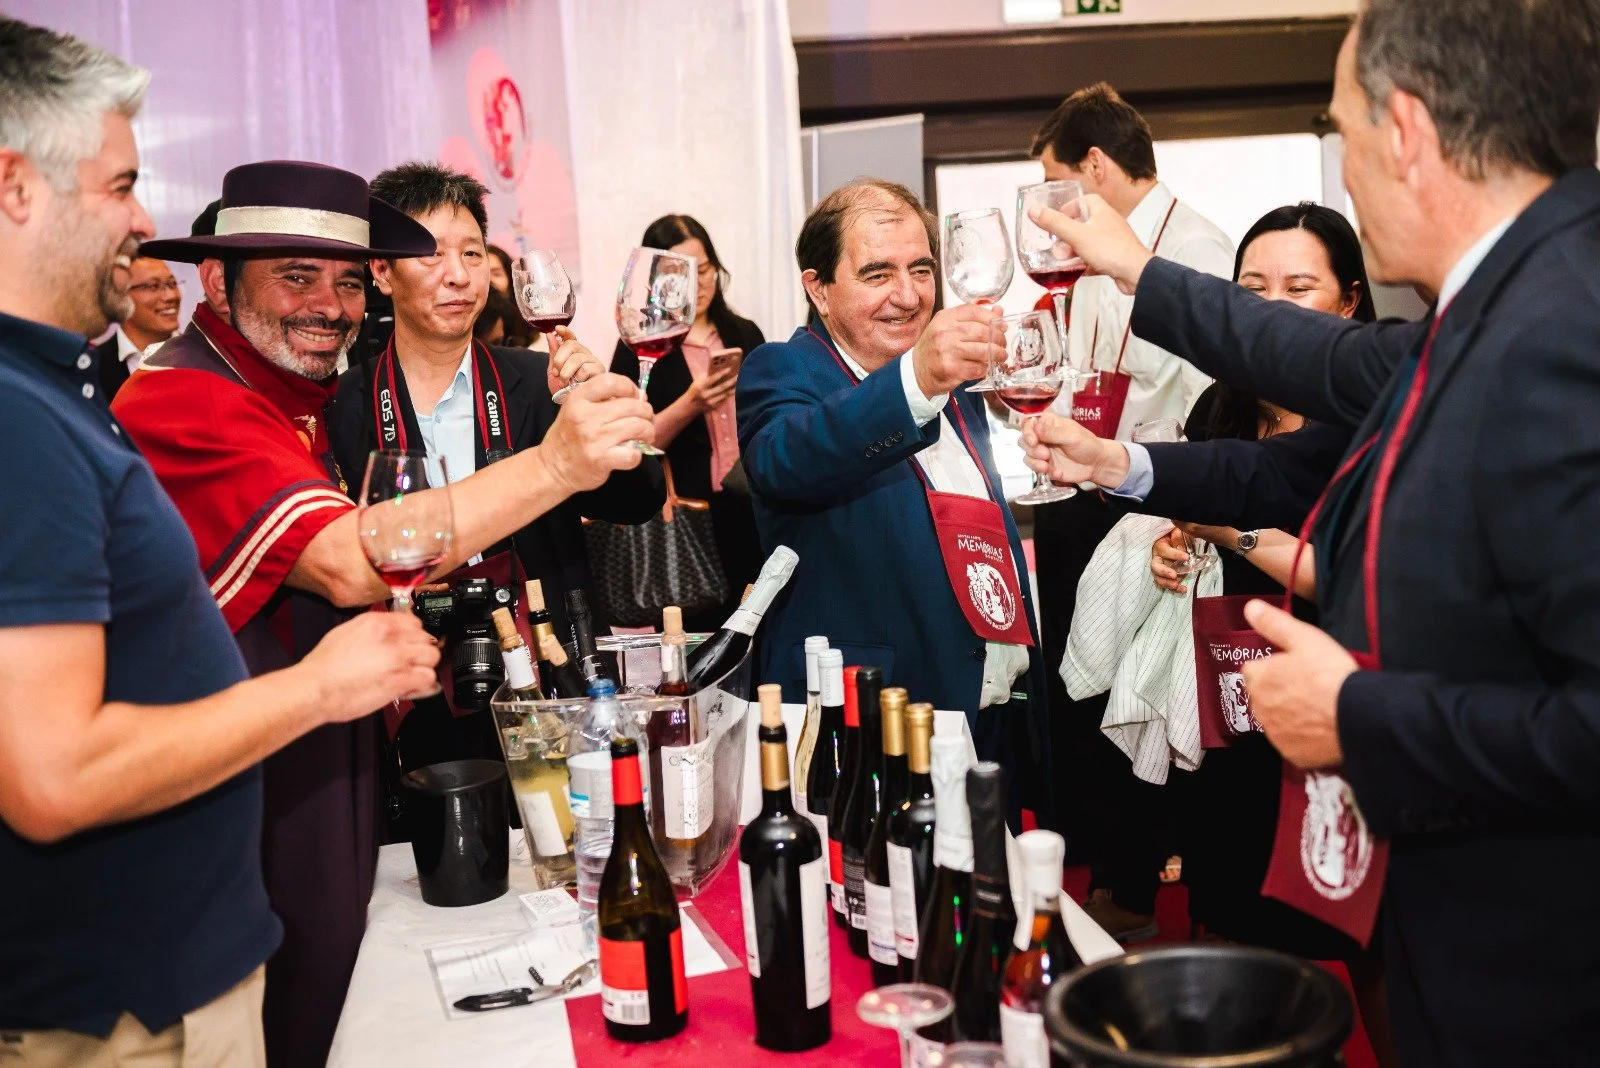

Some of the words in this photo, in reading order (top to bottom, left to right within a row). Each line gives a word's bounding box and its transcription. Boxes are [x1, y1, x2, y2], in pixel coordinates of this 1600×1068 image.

[380, 389, 394, 422] EOS
[485, 390, 501, 436] Canon
[384, 423, 396, 442] 7D
